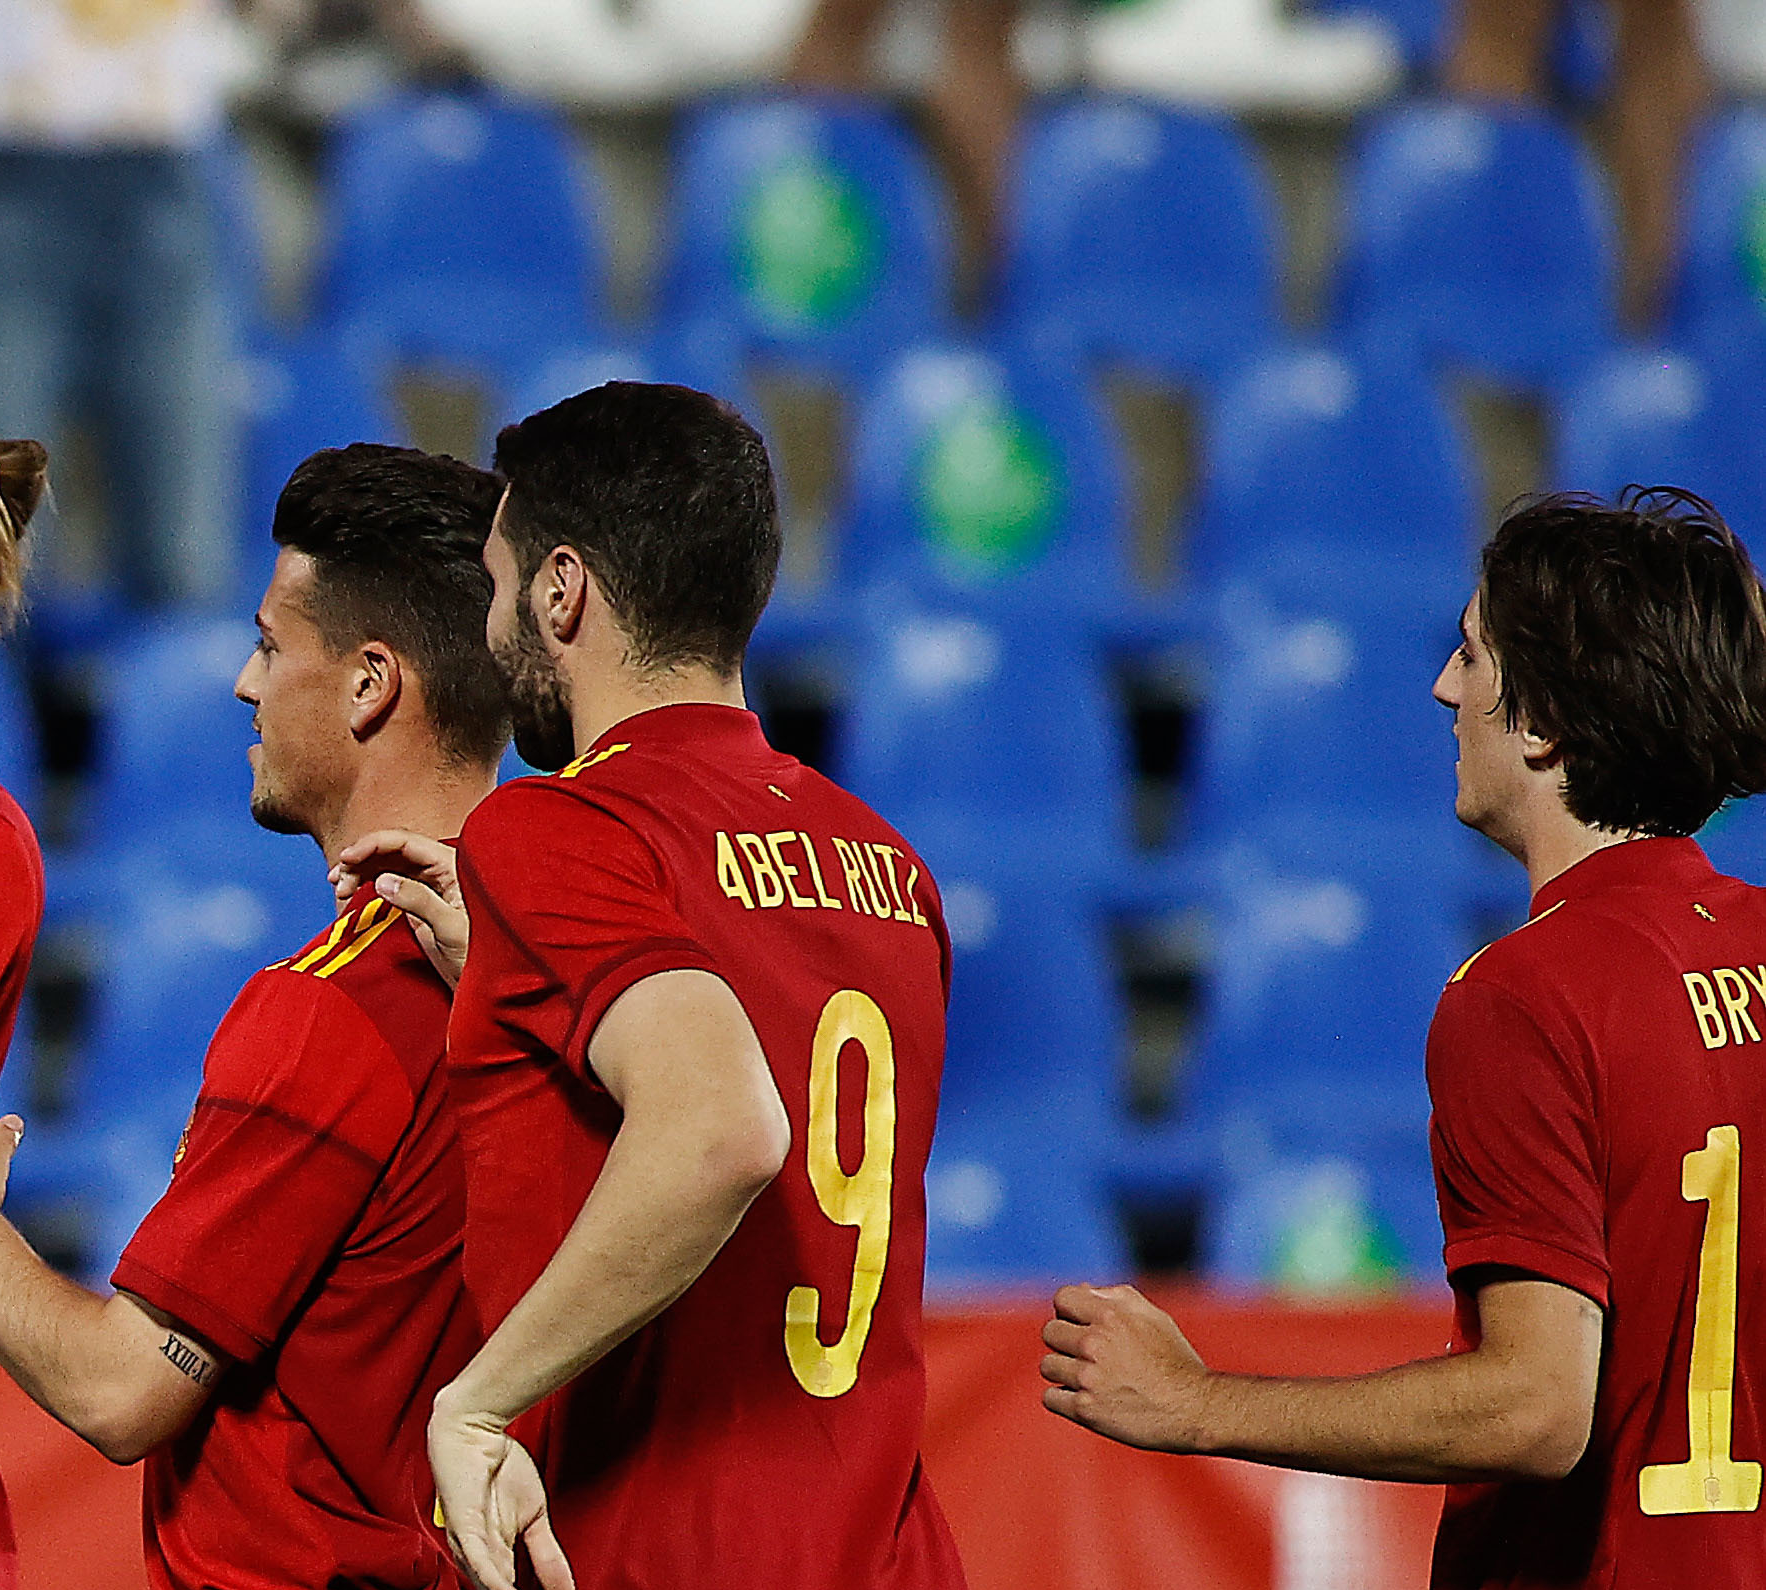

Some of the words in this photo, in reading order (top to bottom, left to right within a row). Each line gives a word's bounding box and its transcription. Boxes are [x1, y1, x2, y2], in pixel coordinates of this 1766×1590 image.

[716, 831, 844, 910] ABEL
[785, 989, 896, 1398] 9
[1639, 1125, 1762, 1515] 1
